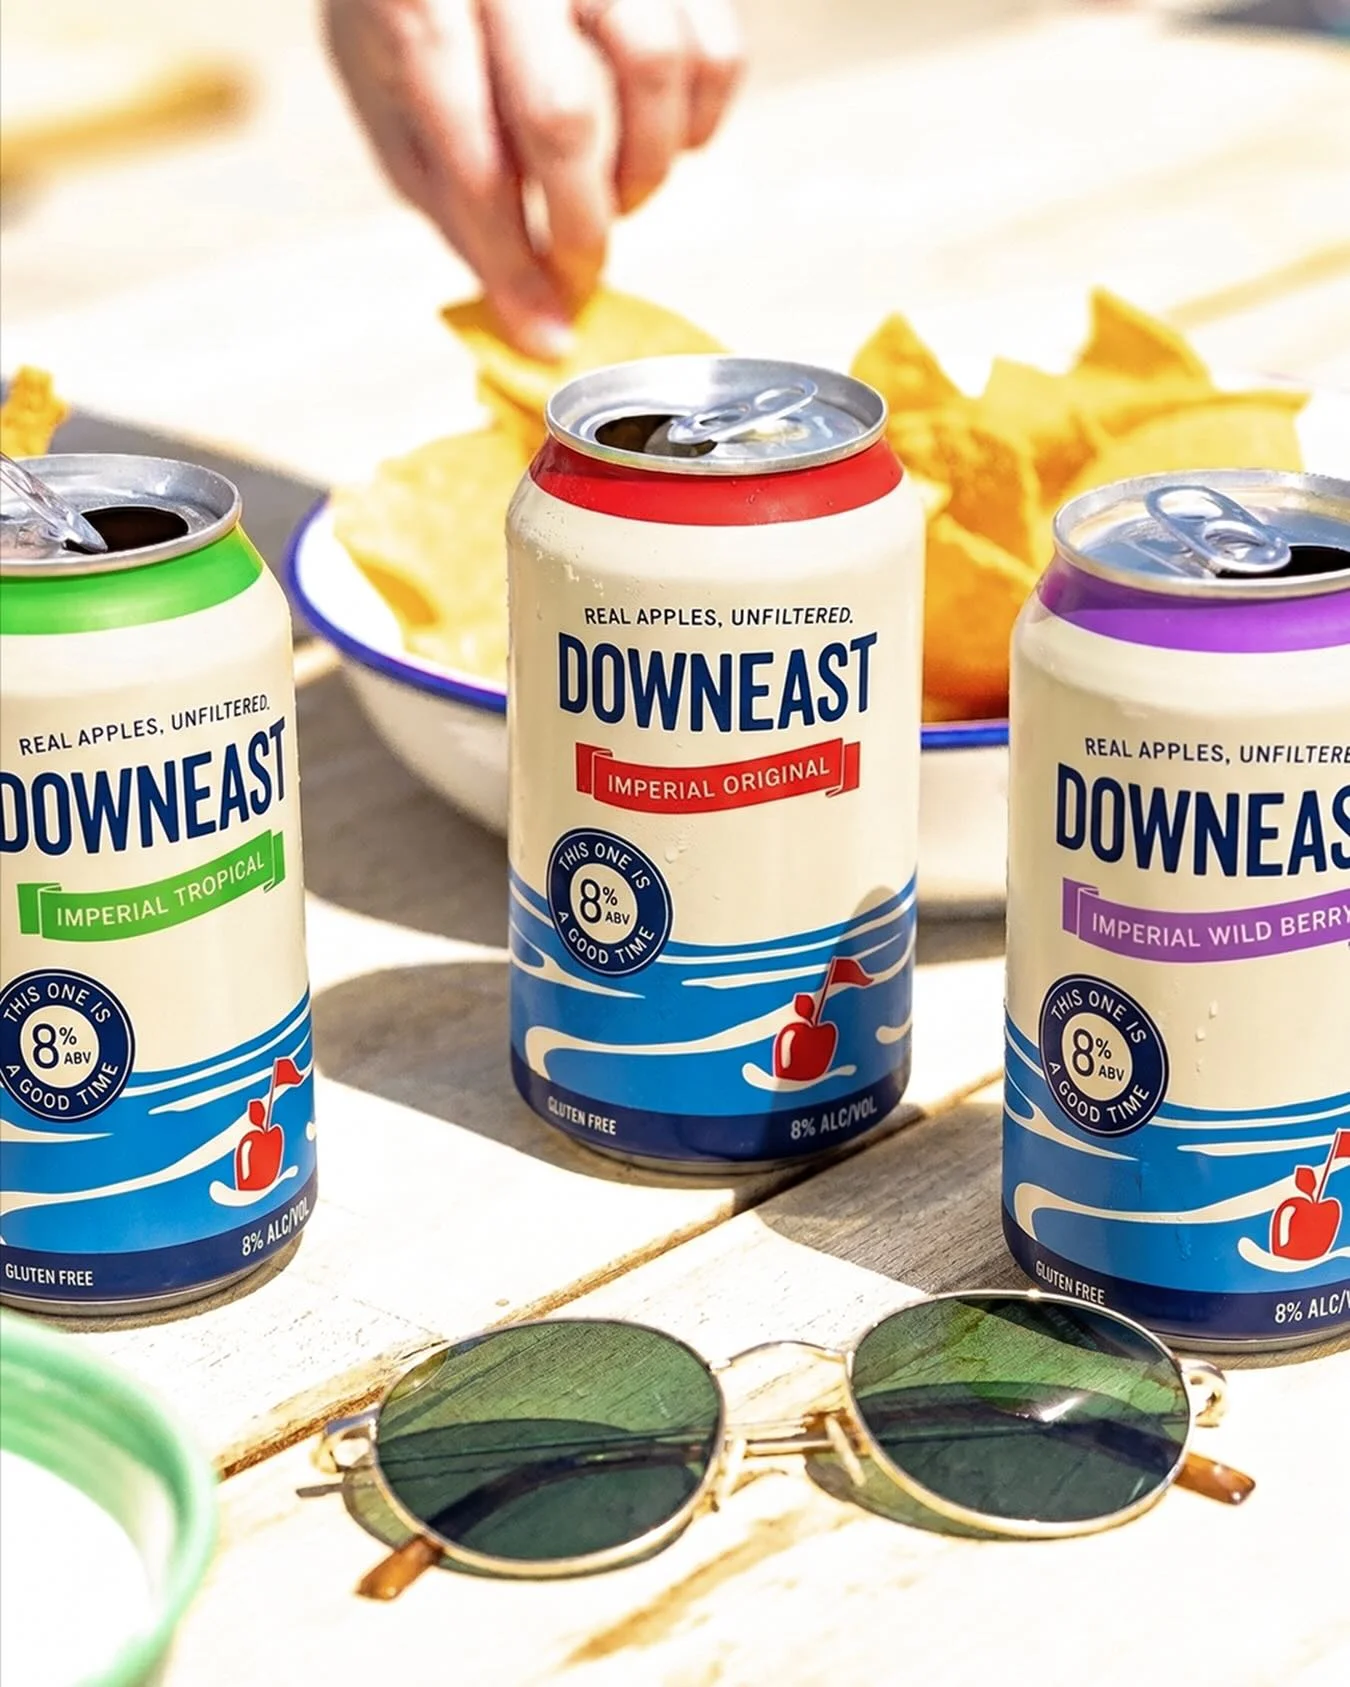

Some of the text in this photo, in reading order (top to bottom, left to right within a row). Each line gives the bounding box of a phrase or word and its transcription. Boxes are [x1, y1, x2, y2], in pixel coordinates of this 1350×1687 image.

[584, 607, 853, 628] REAL APPLES, UNFILTERED.
[559, 631, 877, 732] DOWNEAST
[19, 694, 271, 756] REAL APPLES, UNFILTERED.
[1085, 737, 1132, 758] REAL
[1139, 741, 1230, 765] APPLES,
[0, 716, 285, 856] DOWNEAST
[608, 756, 830, 800] IMPERIAL ORIGINAL
[1057, 762, 1350, 877] DOWNEAS
[558, 842, 650, 889] THIS ONE IS
[57, 851, 265, 927] IMPERIAL TROPICAL
[558, 911, 655, 964] A GOOD TIME
[605, 912, 630, 925] ABV
[1092, 912, 1200, 947] IMPERIAL
[1208, 922, 1273, 946] WILD
[3, 983, 111, 1023] THIS ONE IS
[1051, 989, 1147, 1043] THIS ONE IS
[64, 1052, 91, 1065] ABV
[1098, 1065, 1125, 1081] ABV
[6, 1062, 119, 1111] A GOOD TIME
[1049, 1061, 1150, 1123] A GOOD TIME
[548, 1096, 617, 1135] GLUTEN FREE
[791, 1095, 877, 1140] 8% ALC/VOL
[242, 1196, 310, 1256] 8% ALC/VOL
[5, 1263, 93, 1286] GLUTEN FREE
[1035, 1260, 1105, 1306] GLUTEN FREE
[1275, 1301, 1303, 1323] 8%
